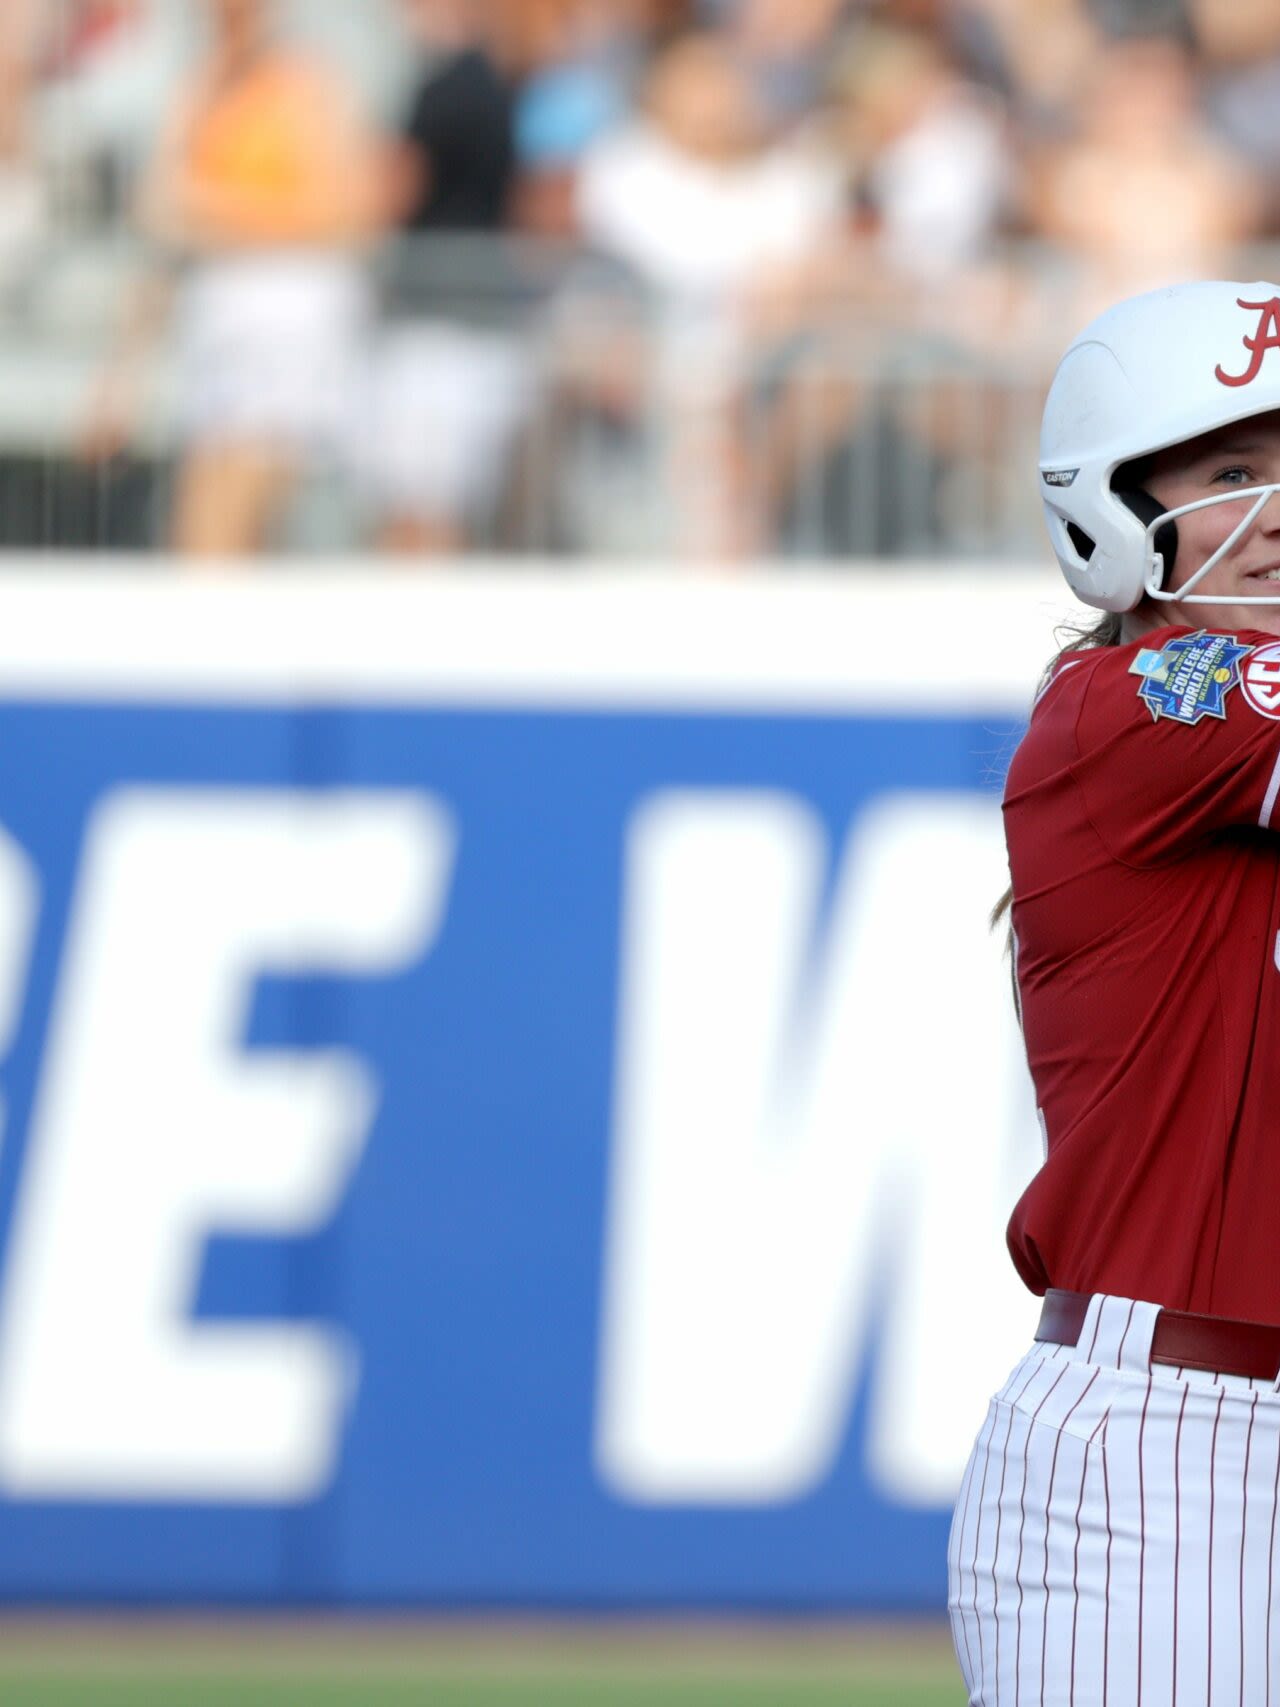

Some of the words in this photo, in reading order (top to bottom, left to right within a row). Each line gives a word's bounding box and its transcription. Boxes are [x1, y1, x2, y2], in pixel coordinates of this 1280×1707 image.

[1046, 471, 1074, 483] EASTON
[1171, 646, 1205, 695] COLLEGE
[1178, 671, 1205, 718] WORLD
[1197, 637, 1228, 672] SERIES
[0, 783, 458, 1507] E
